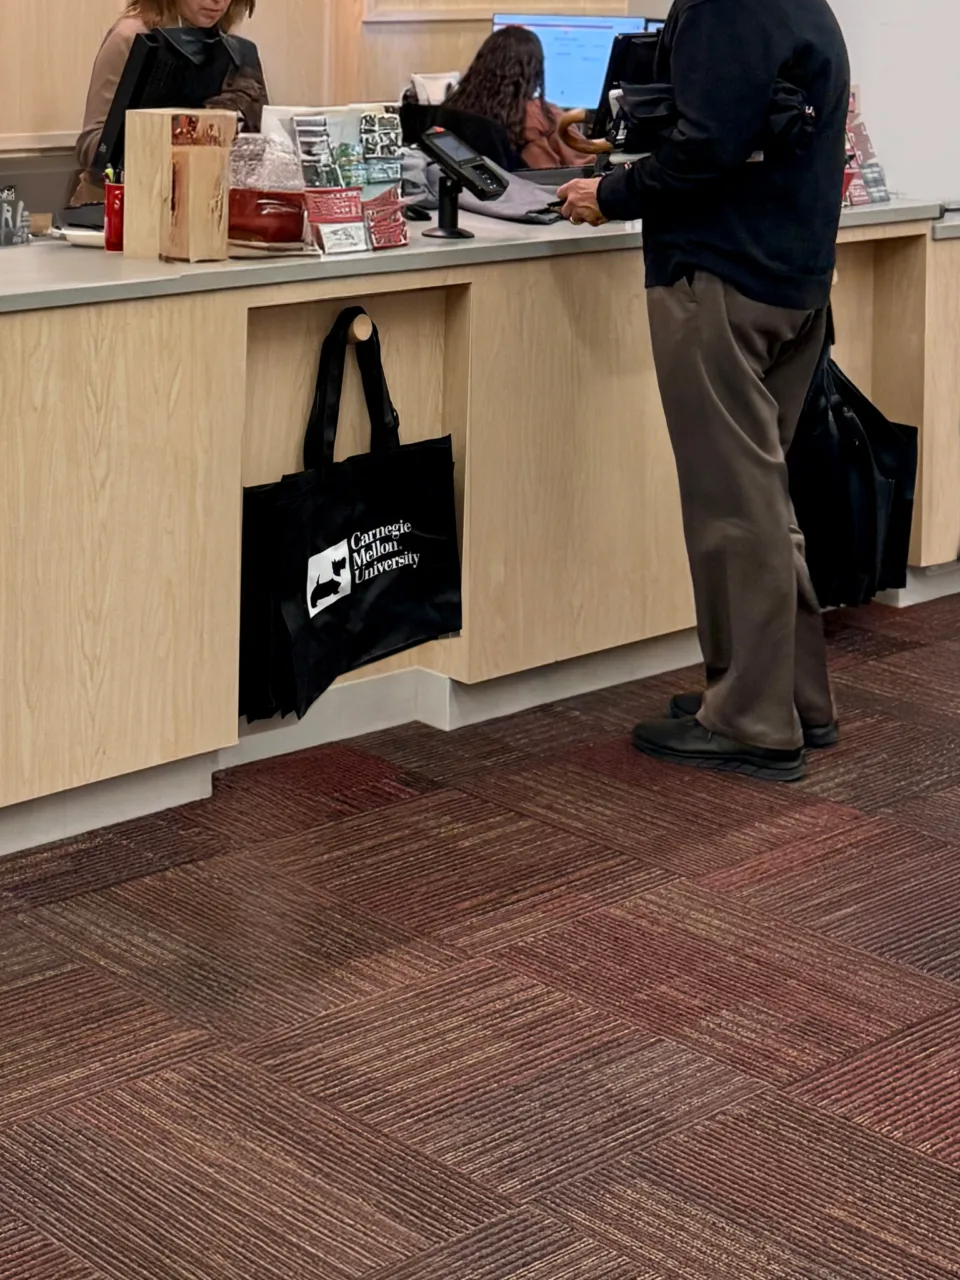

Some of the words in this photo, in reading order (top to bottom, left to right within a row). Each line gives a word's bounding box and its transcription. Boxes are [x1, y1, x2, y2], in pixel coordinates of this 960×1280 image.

[350, 519, 412, 550] Carnegie
[352, 540, 398, 570] Mellon
[354, 551, 420, 584] University
